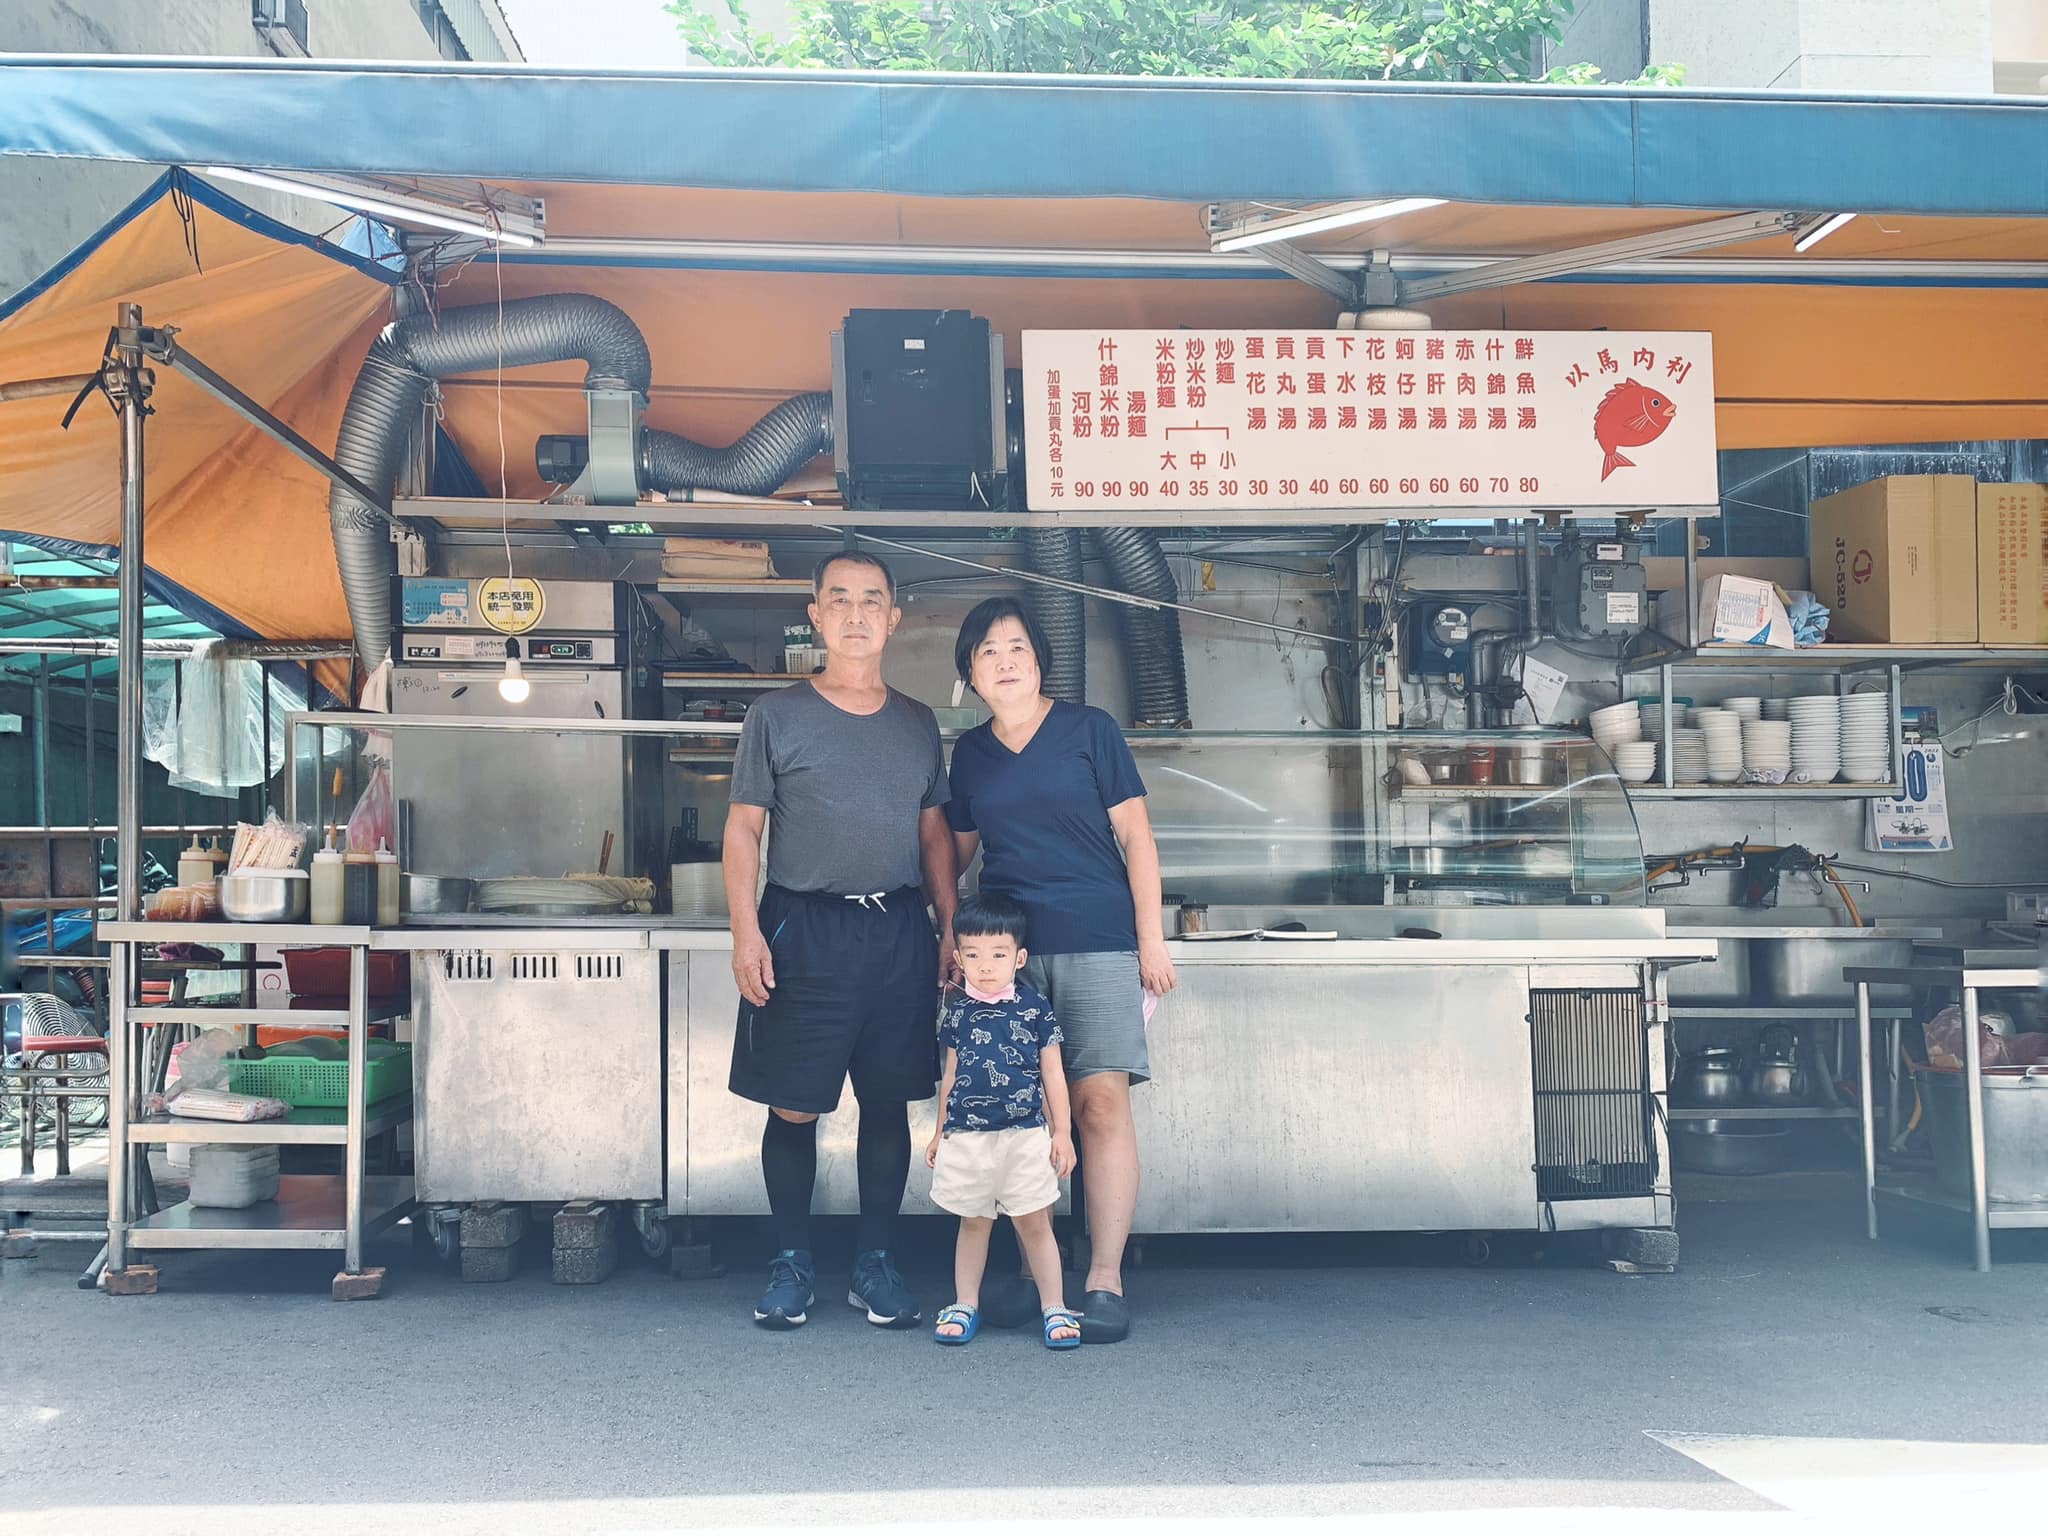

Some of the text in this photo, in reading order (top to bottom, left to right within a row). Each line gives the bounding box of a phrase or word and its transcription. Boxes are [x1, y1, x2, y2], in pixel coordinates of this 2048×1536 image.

[1156, 338, 1177, 409] 米粉麵
[1185, 338, 1207, 409] 炒米粉
[1215, 338, 1236, 385] 炒麵
[1246, 337, 1268, 430] 蛋花湯
[1275, 337, 1297, 430] 貢丸湯
[1306, 337, 1328, 430] 貢蛋湯
[1335, 337, 1358, 430] 下水湯
[1365, 337, 1388, 430] 花枝湯
[1396, 337, 1418, 430] 蚵仔湯
[1426, 337, 1448, 430] 豬肝湯
[1455, 337, 1478, 430] 赤肉湯
[1485, 337, 1508, 430] 什錦湯
[1514, 337, 1537, 430] 鮮魚湯
[1047, 369, 1065, 497] 加蛋加貢丸各10元
[1072, 391, 1093, 439] 河粉
[1127, 390, 1149, 438] 湯麵
[1160, 450, 1237, 471] 大 中 小
[1074, 477, 1540, 498] 90 90 90 40 35 30 30 30 40 60 60 60 60 60 70 80
